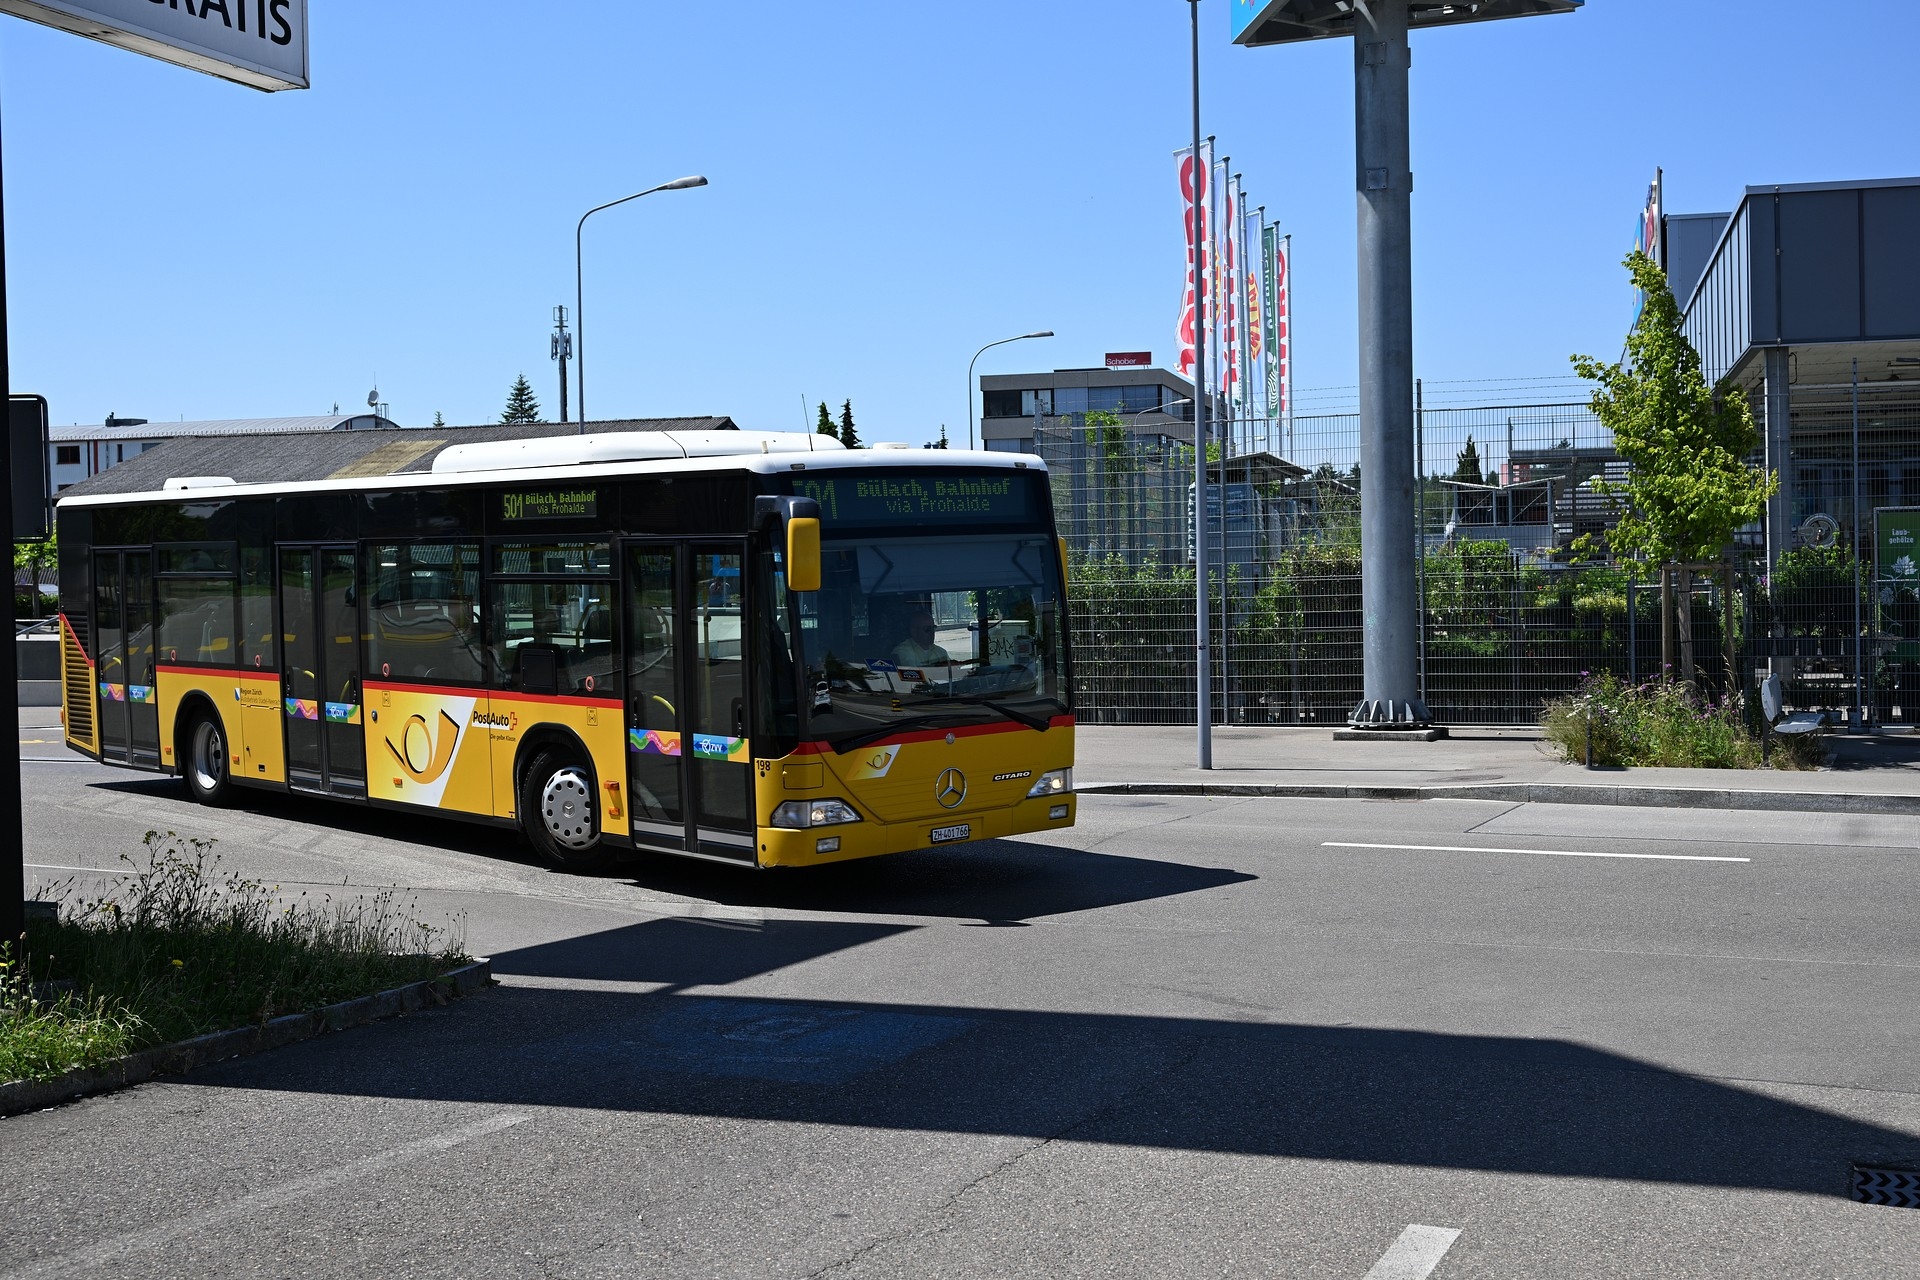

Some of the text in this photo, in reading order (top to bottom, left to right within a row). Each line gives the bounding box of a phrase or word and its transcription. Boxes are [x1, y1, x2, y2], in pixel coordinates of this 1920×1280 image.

[1106, 358, 1137, 366] Schober
[857, 478, 1010, 499] Bülach, Bahnhof
[525, 490, 597, 505] Bülach, Bahnhof
[503, 494, 523, 519] 501
[537, 505, 549, 515] via
[473, 711, 509, 726] PostAuto
[756, 760, 771, 771] 198
[994, 771, 1030, 781] CITARO
